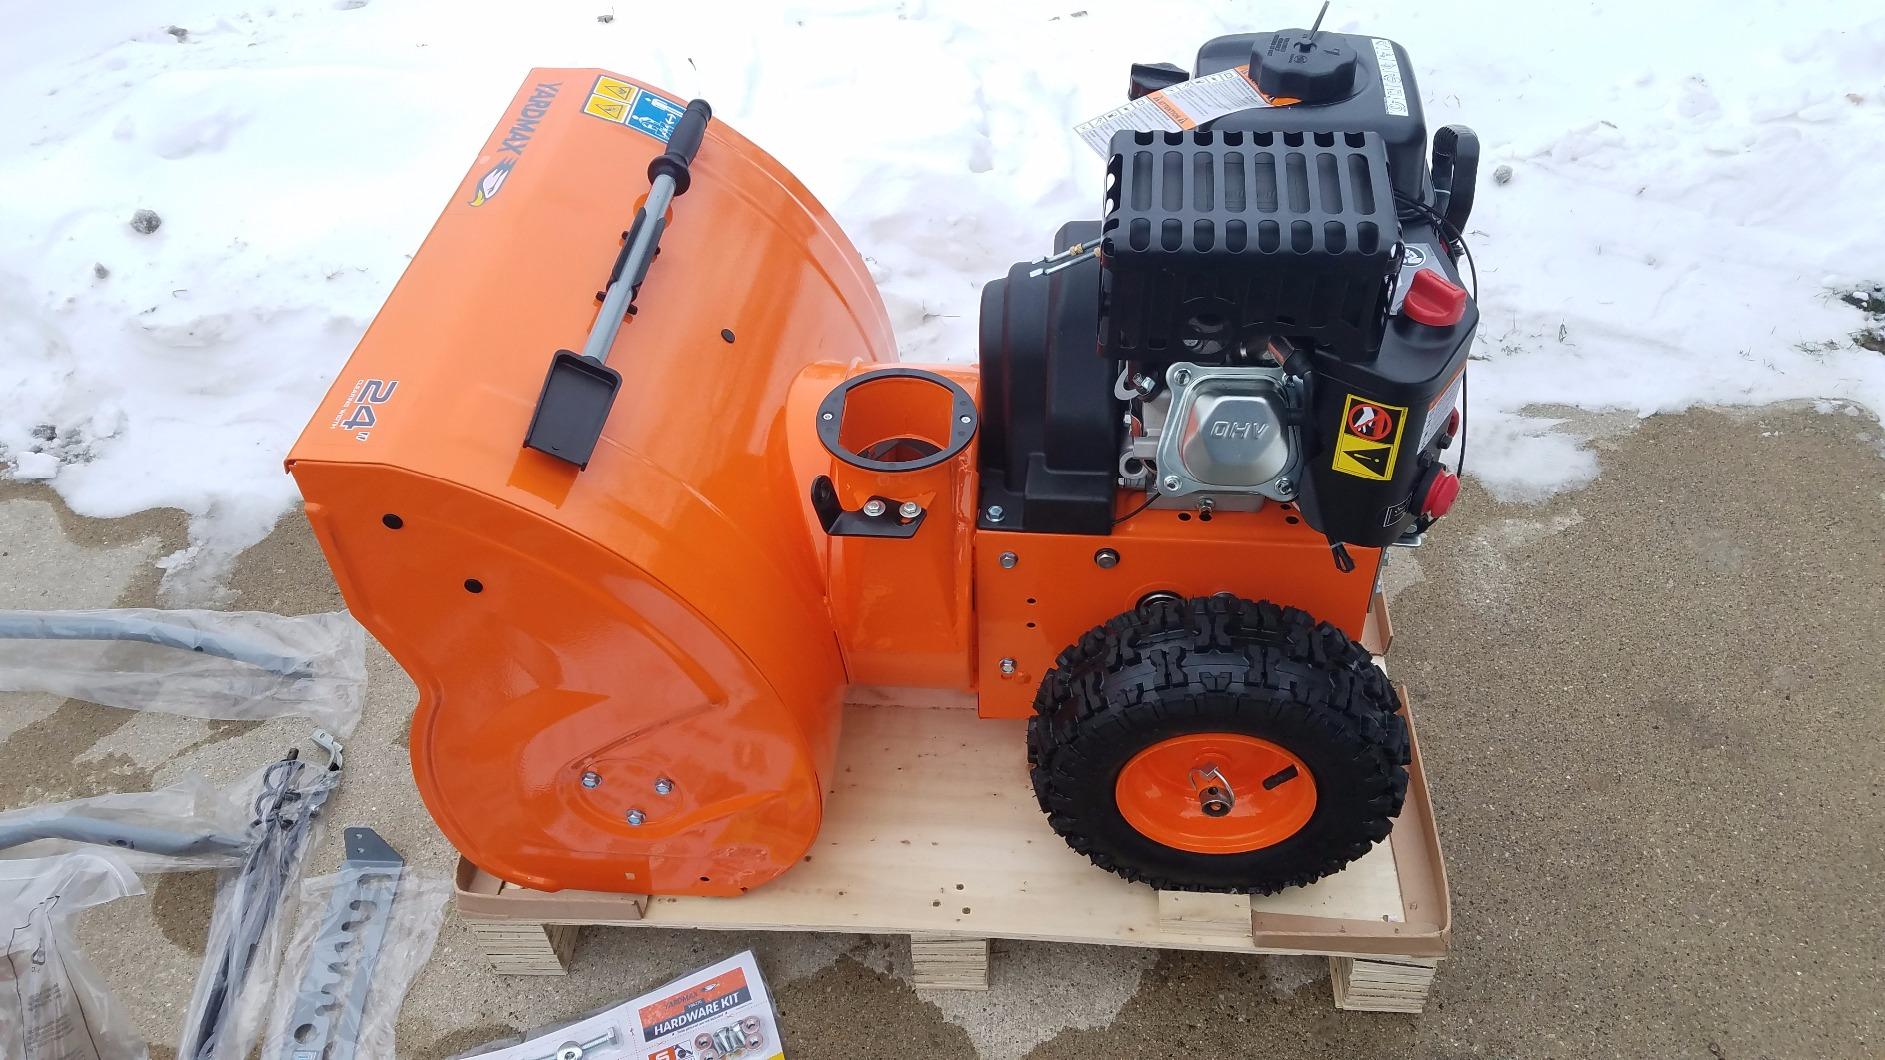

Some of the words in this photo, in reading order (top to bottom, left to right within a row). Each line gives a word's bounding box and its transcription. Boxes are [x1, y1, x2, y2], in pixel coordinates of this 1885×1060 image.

[496, 82, 563, 156] YARDMAX
[1210, 420, 1269, 441] OHV
[654, 1002, 720, 1036] HARDWARE
[721, 991, 740, 1009] KIT
